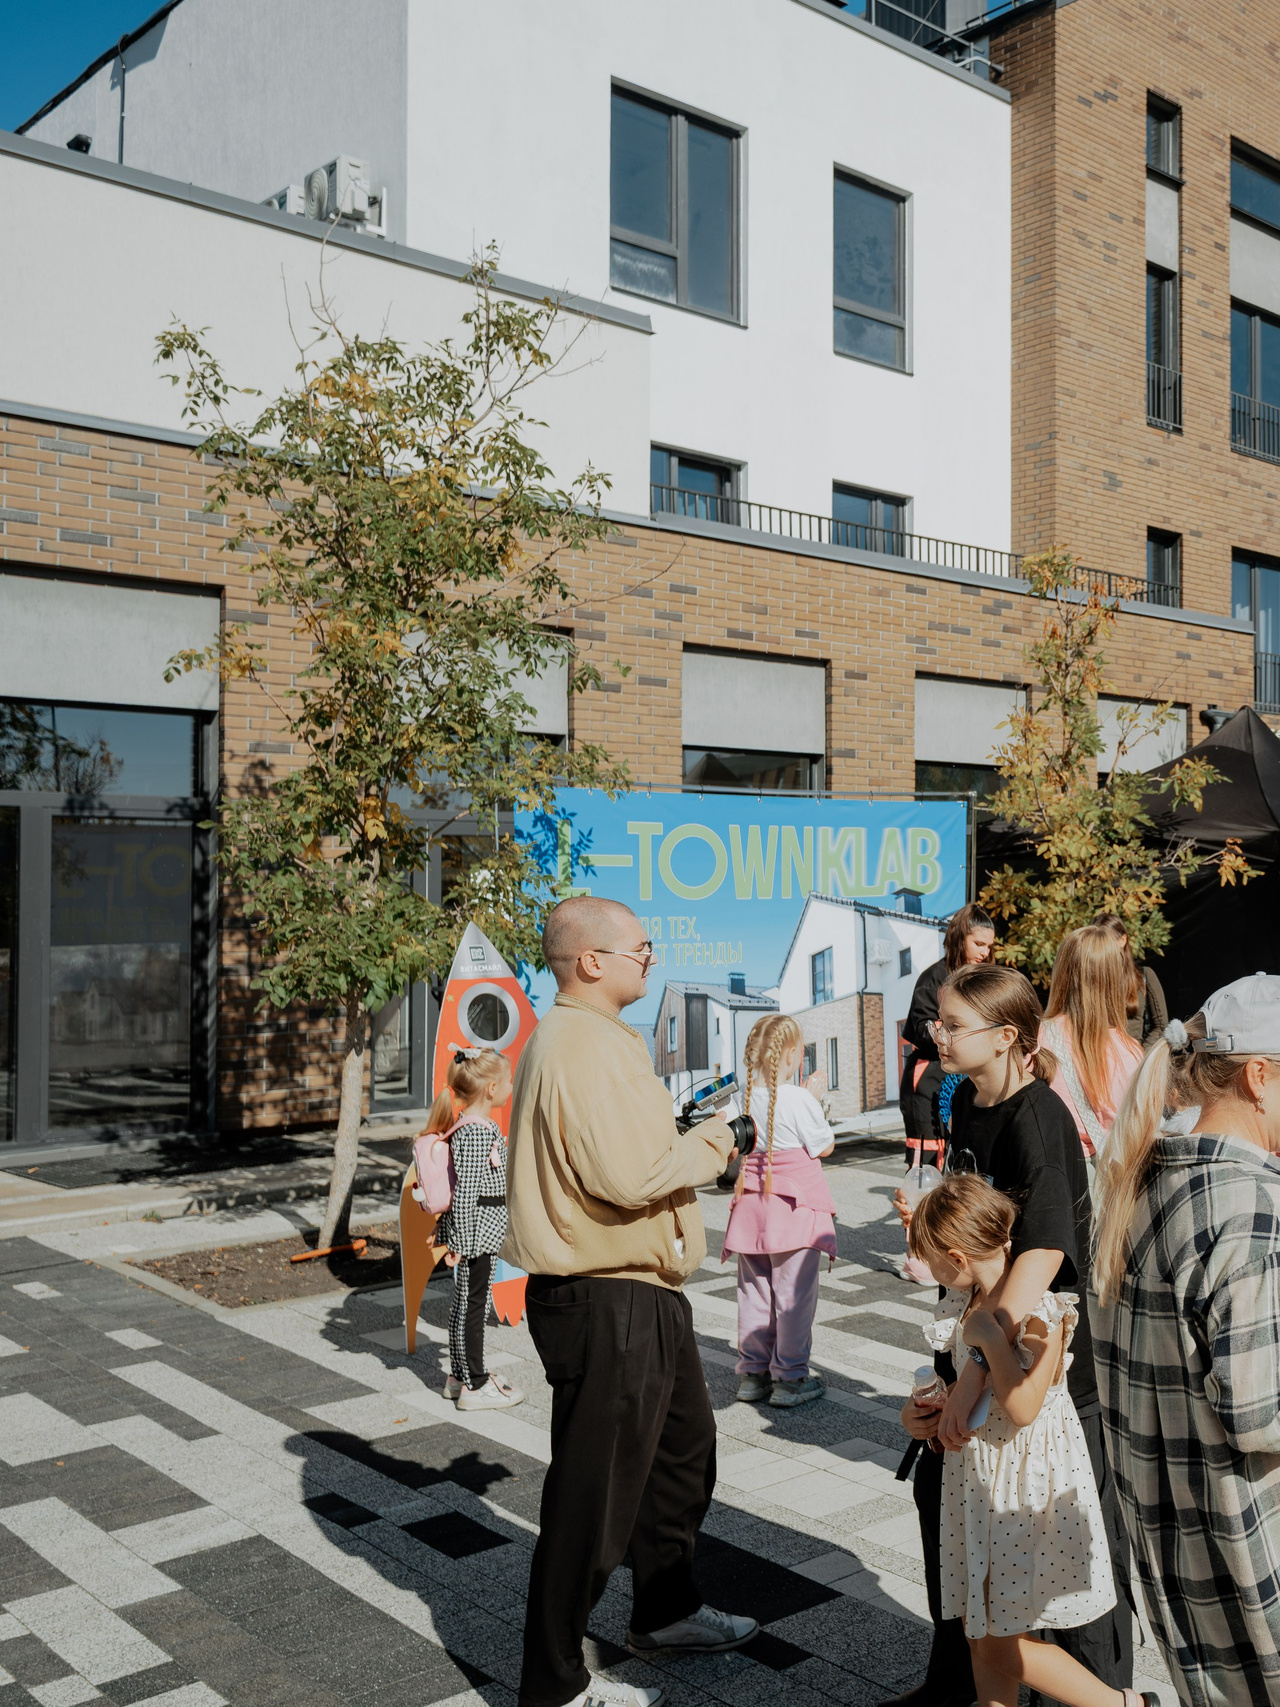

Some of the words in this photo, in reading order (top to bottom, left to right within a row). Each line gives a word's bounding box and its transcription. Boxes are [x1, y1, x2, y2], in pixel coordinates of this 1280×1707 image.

[639, 916, 662, 940] ЛЯ
[667, 916, 701, 941] ТЕХ,
[673, 941, 743, 967] ТРЕНДЫ
[460, 963, 502, 973] ВИТАСМАЙЛ
